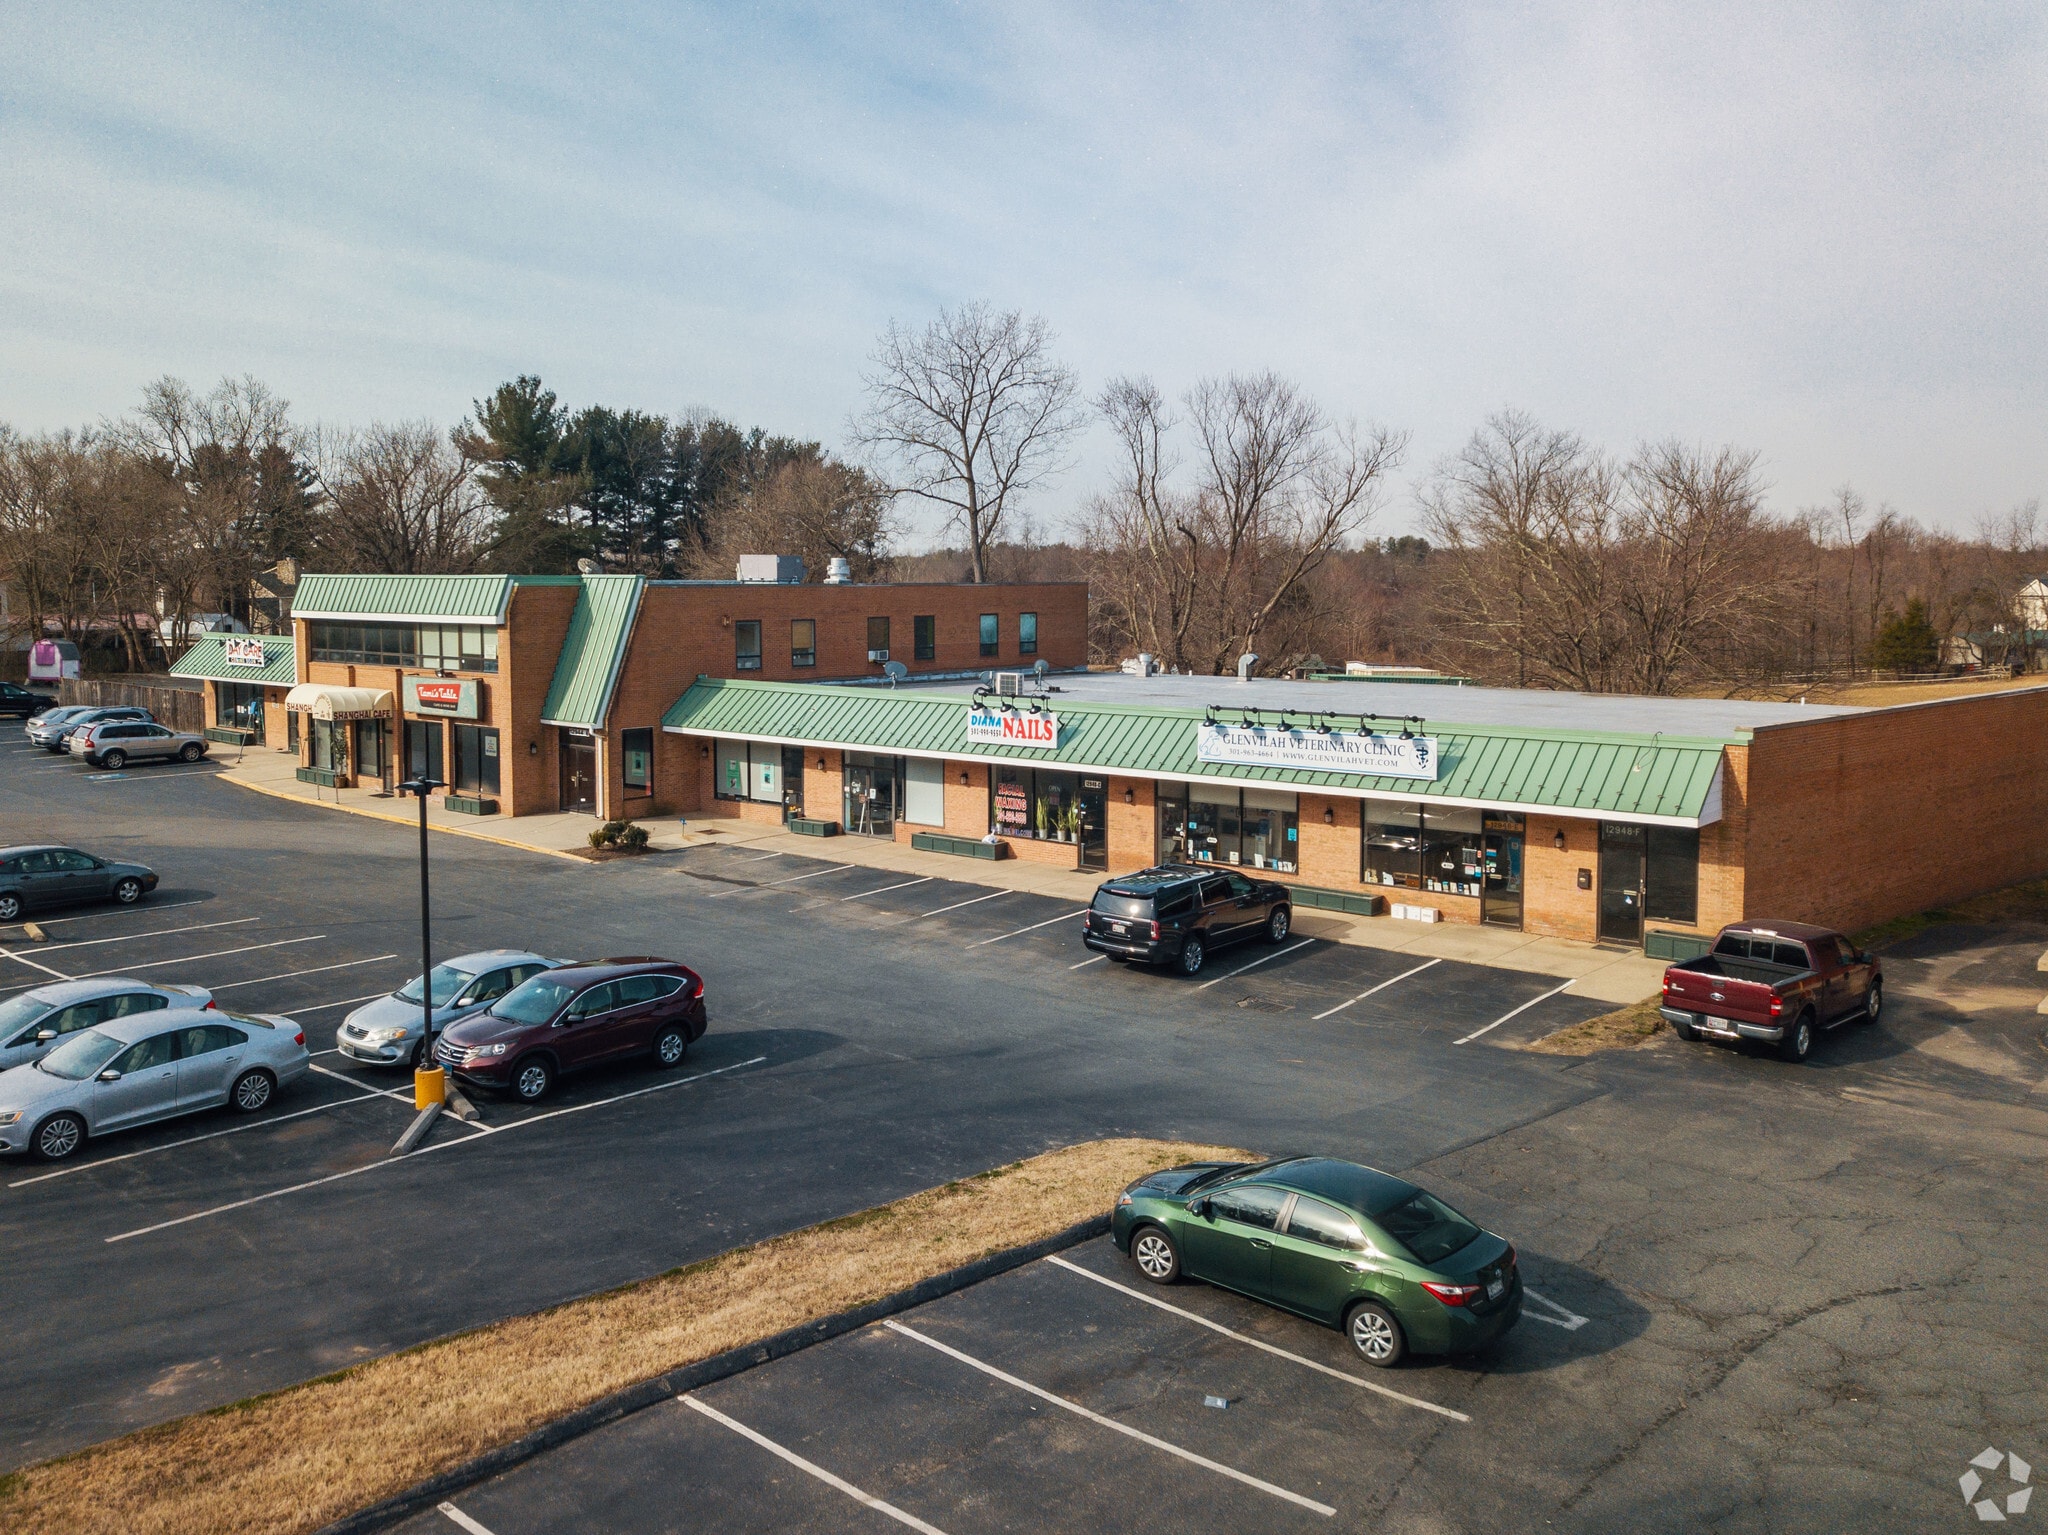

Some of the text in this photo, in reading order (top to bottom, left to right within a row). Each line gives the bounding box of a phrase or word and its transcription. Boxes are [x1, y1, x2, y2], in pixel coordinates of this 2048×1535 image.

[228, 643, 262, 658] DAY CARE
[439, 687, 458, 700] Table
[286, 702, 312, 712] SHANGH
[333, 710, 371, 720] SHANGHAI
[373, 709, 391, 718] CAFE
[971, 715, 1002, 727] DIANA
[1002, 717, 1053, 741] NAILS
[1222, 733, 1406, 757] GLENVILAH VETERINARY CLINIC
[1229, 748, 1398, 767] 301-963-4664 WWW.GLENVILAHVET.COM
[995, 796, 1027, 811] WAXING
[1606, 824, 1641, 836] 12948-F
